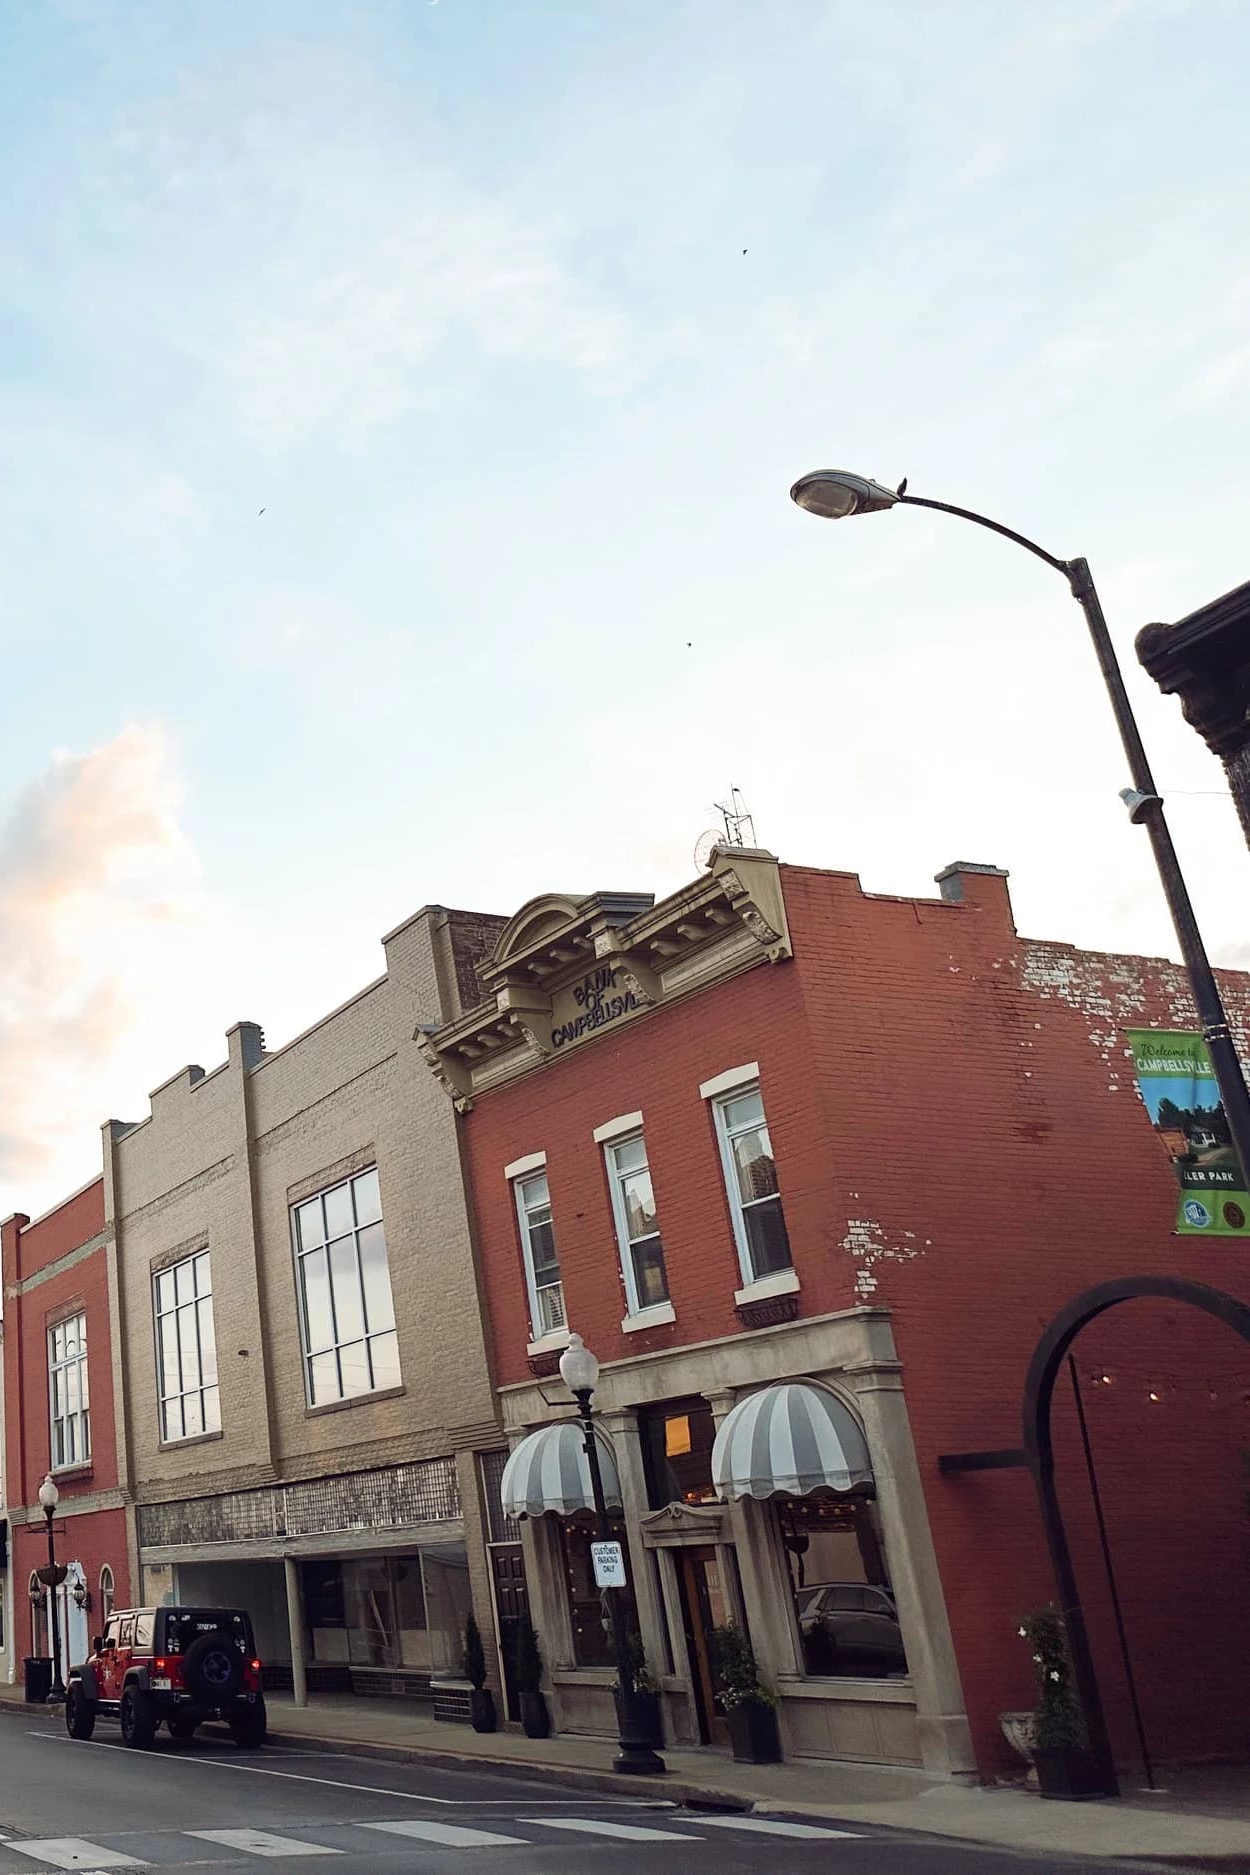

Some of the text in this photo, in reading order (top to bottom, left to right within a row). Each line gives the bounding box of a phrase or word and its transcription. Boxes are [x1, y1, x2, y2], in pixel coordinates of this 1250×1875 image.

[573, 967, 616, 1006] BANK
[585, 993, 605, 1012] OF
[1141, 1043, 1184, 1057] Welcome
[1208, 1171, 1234, 1182] PARK
[597, 1556, 619, 1564] PARKING
